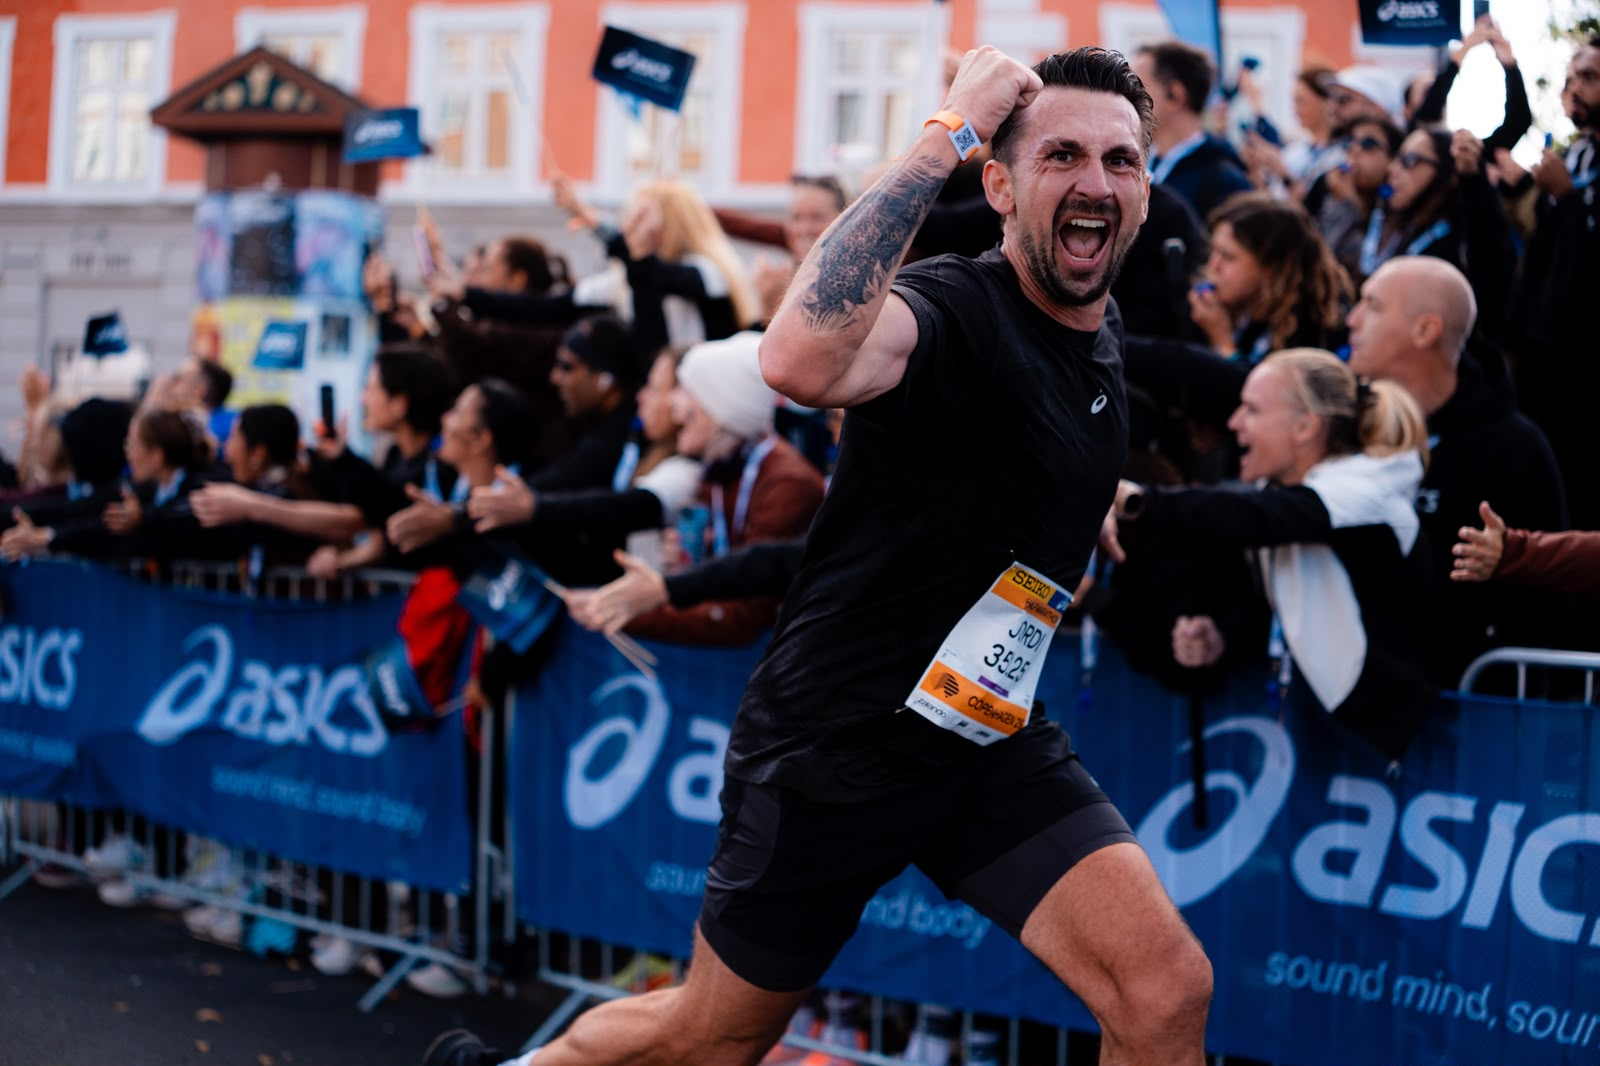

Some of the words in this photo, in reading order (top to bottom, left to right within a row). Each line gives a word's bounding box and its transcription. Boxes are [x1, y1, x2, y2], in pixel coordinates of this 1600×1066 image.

[1012, 569, 1052, 600] SEIKO
[1009, 620, 1047, 653] JORDI
[983, 643, 1031, 683] 3525
[967, 695, 1015, 726] COPENHAGEN
[1291, 773, 1600, 947] asic
[1264, 951, 1388, 1001] sound
[1392, 968, 1497, 1030] mind,
